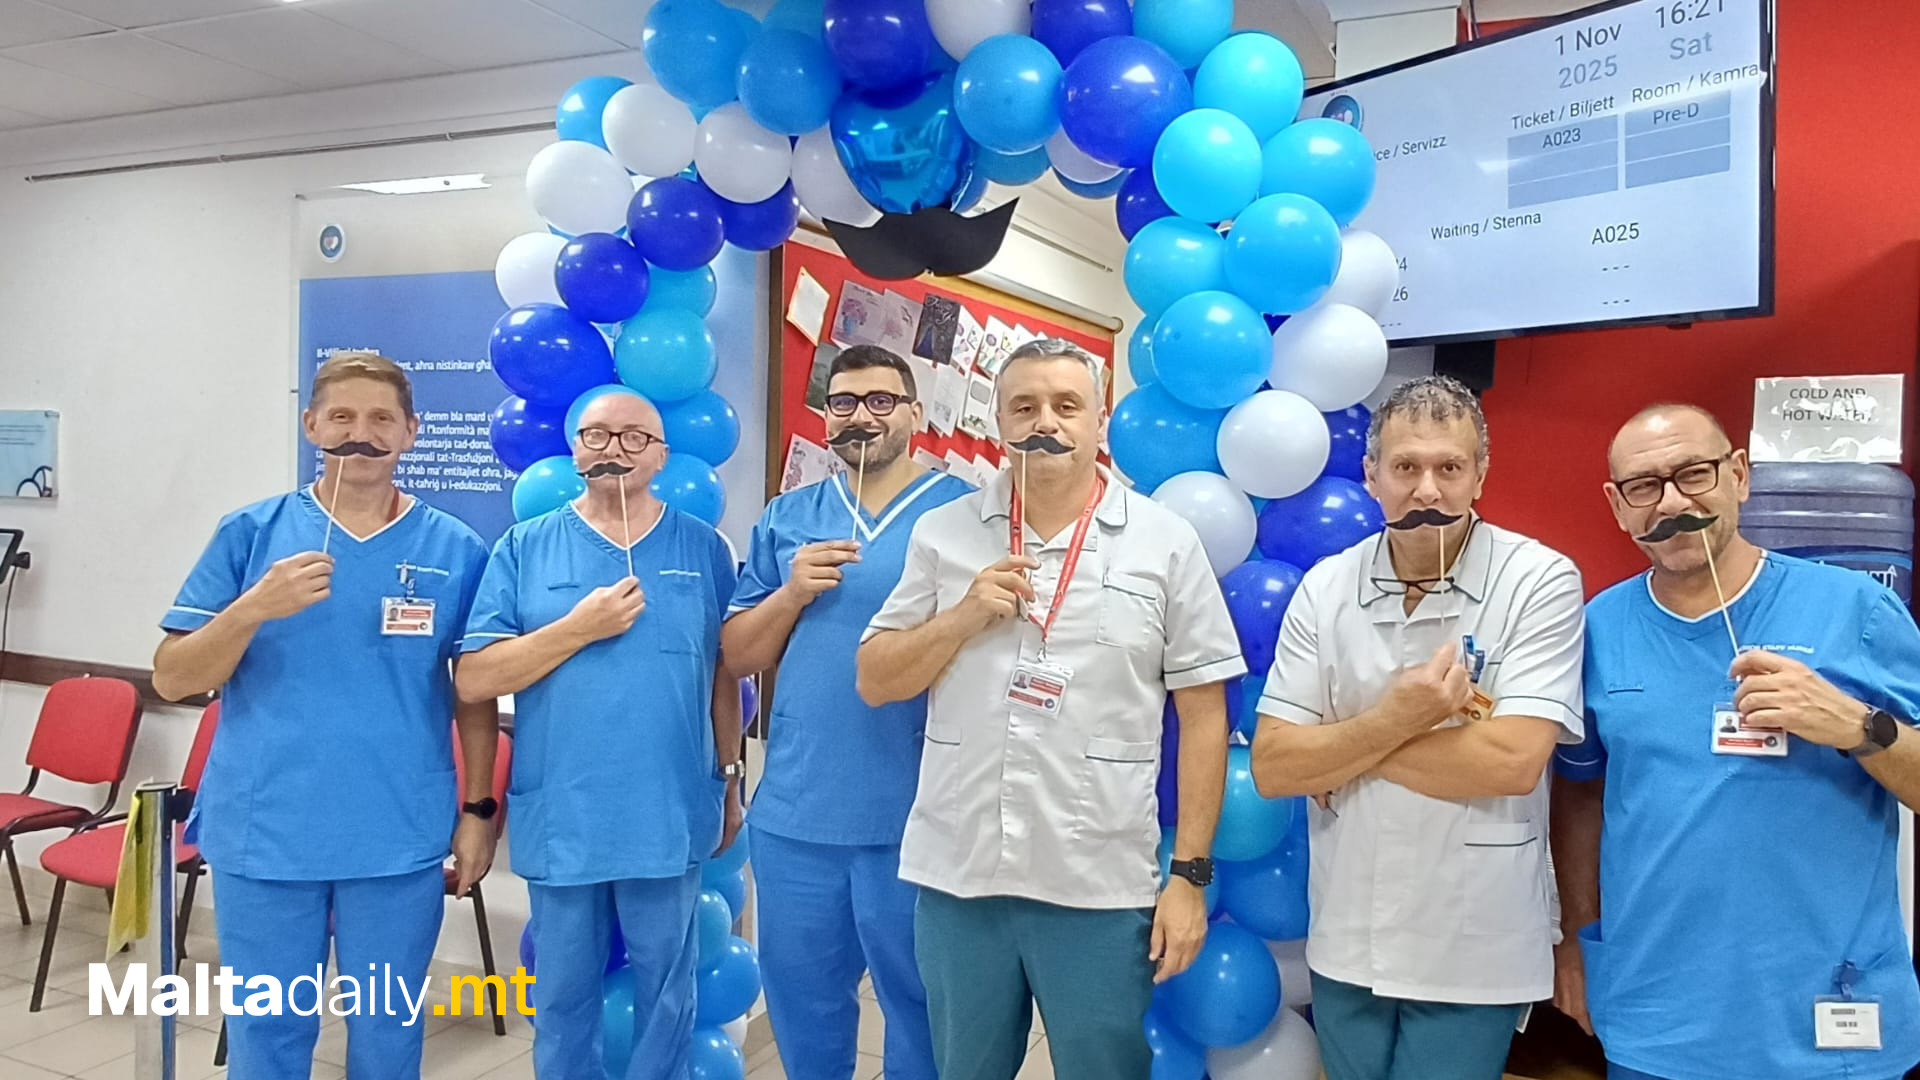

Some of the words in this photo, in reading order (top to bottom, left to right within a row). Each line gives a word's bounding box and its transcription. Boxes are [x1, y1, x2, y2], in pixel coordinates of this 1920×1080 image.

[1555, 35, 1565, 56] 1
[1576, 23, 1622, 51] Nov
[1669, 32, 1713, 60] Sat
[1559, 55, 1618, 89] 2025
[1631, 81, 1681, 104] Room
[1699, 63, 1759, 87] Kamra
[1511, 110, 1556, 130] Ticket
[1569, 95, 1615, 118] Biljett
[1653, 103, 1699, 125] Pre-D
[1402, 135, 1448, 155] Servizz
[1542, 128, 1582, 149] A023
[1431, 223, 1480, 240] Waiting
[1493, 212, 1542, 231] Stenna
[1591, 222, 1640, 245] A025
[1789, 387, 1829, 400] COLD
[1832, 387, 1867, 400] AND
[1782, 409, 1812, 421] HOT
